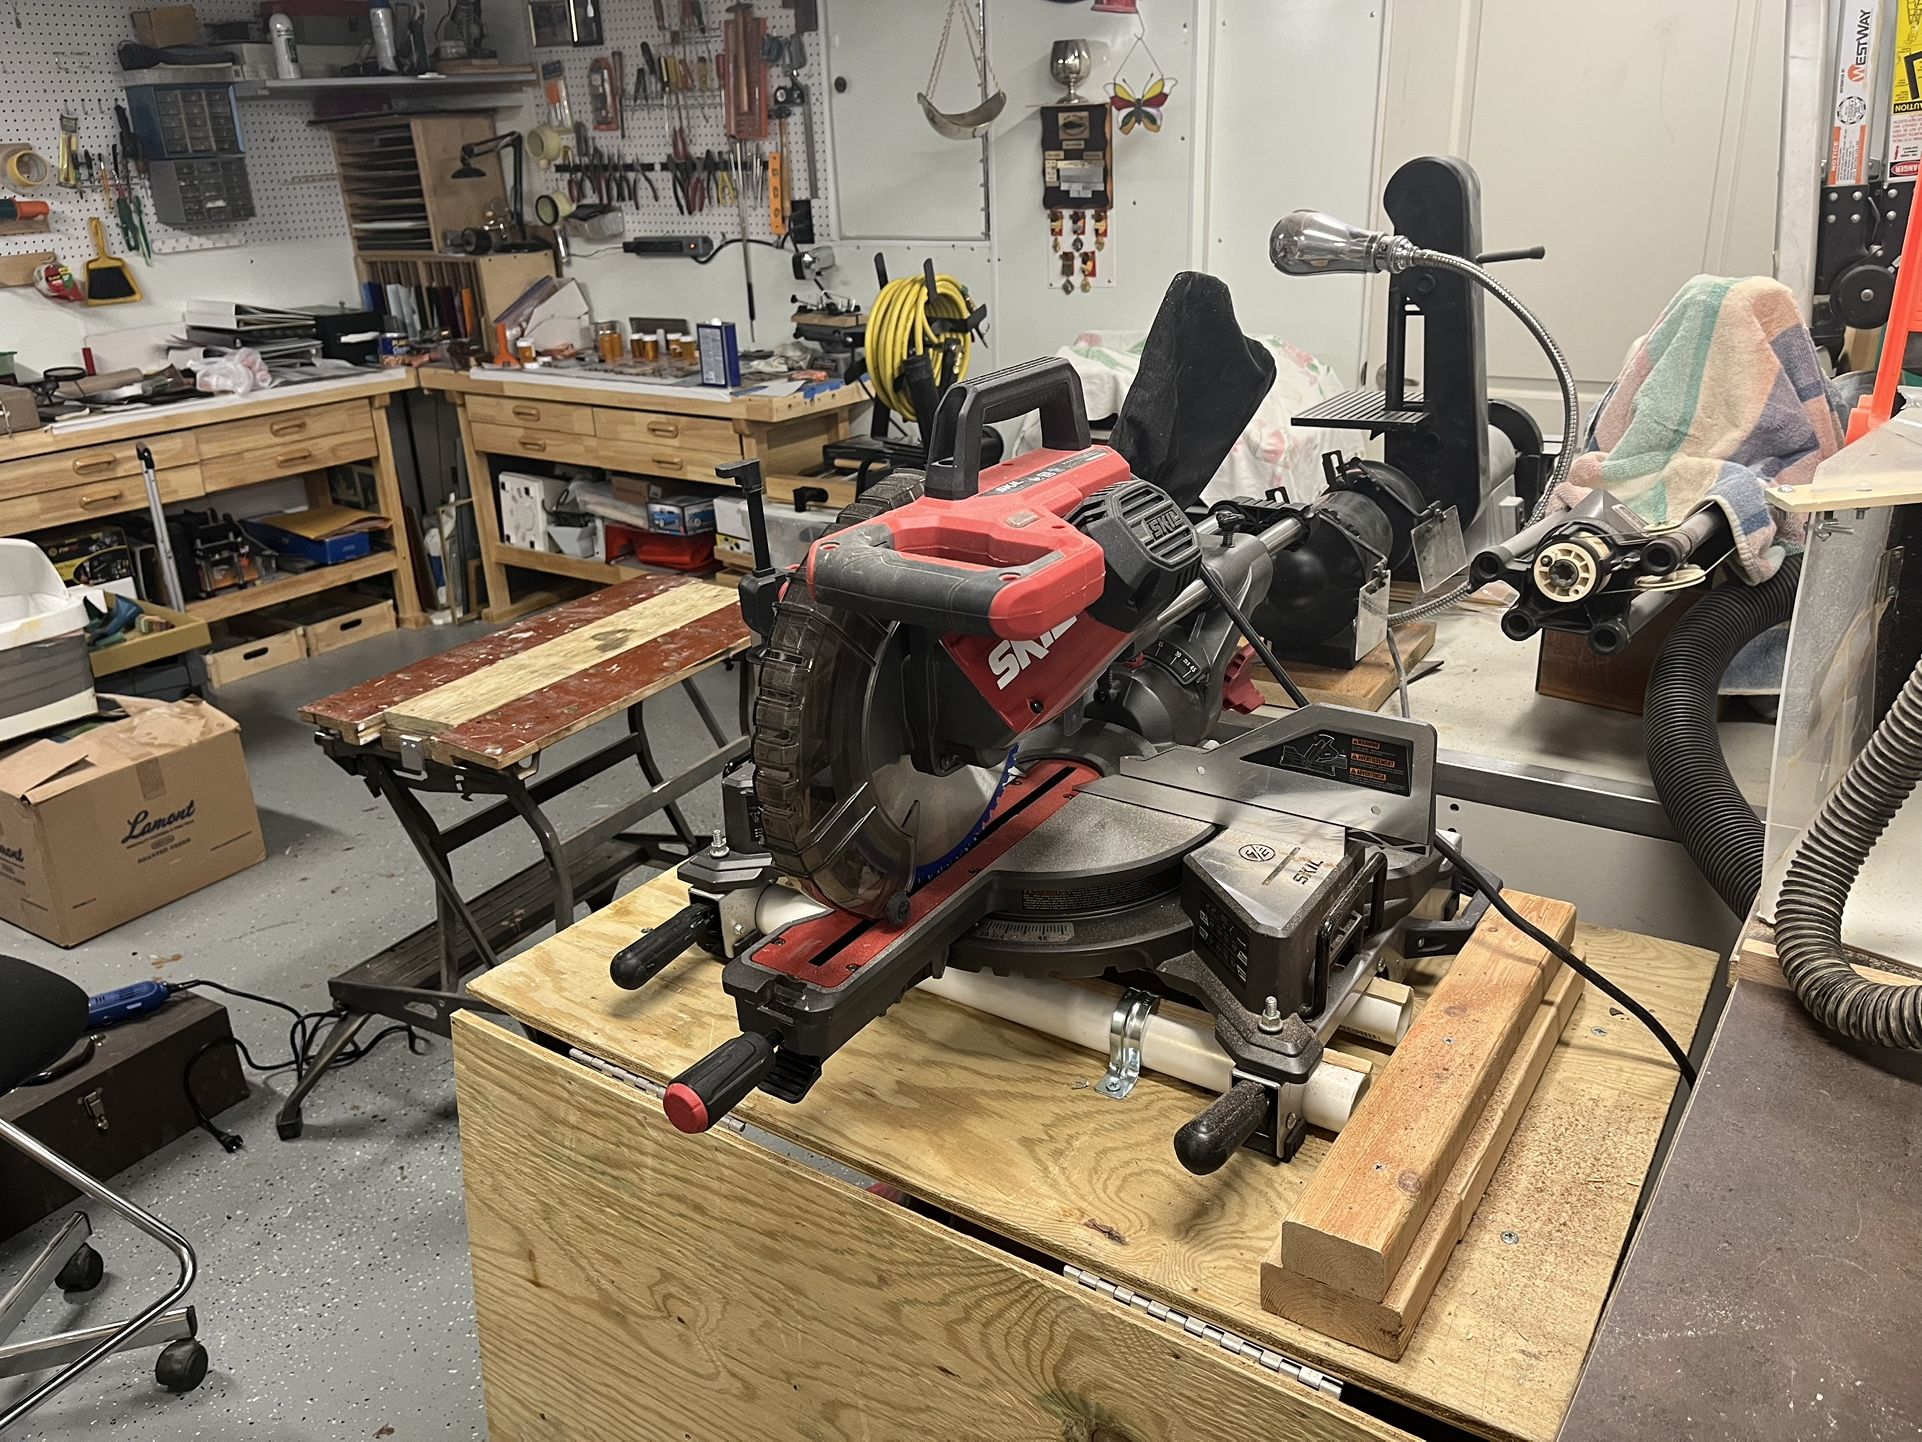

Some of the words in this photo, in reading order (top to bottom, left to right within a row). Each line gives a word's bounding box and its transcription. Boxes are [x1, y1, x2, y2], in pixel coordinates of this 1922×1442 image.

[1850, 9, 1871, 82] WESTWAY
[1895, 101, 1922, 112] AUTION
[1831, 142, 1839, 171] NOTICE
[1895, 164, 1919, 173] ANGER
[1148, 509, 1184, 539] SKIL
[121, 799, 195, 844] Lamont
[0, 845, 24, 863] mont
[1292, 860, 1324, 886] SKIL
